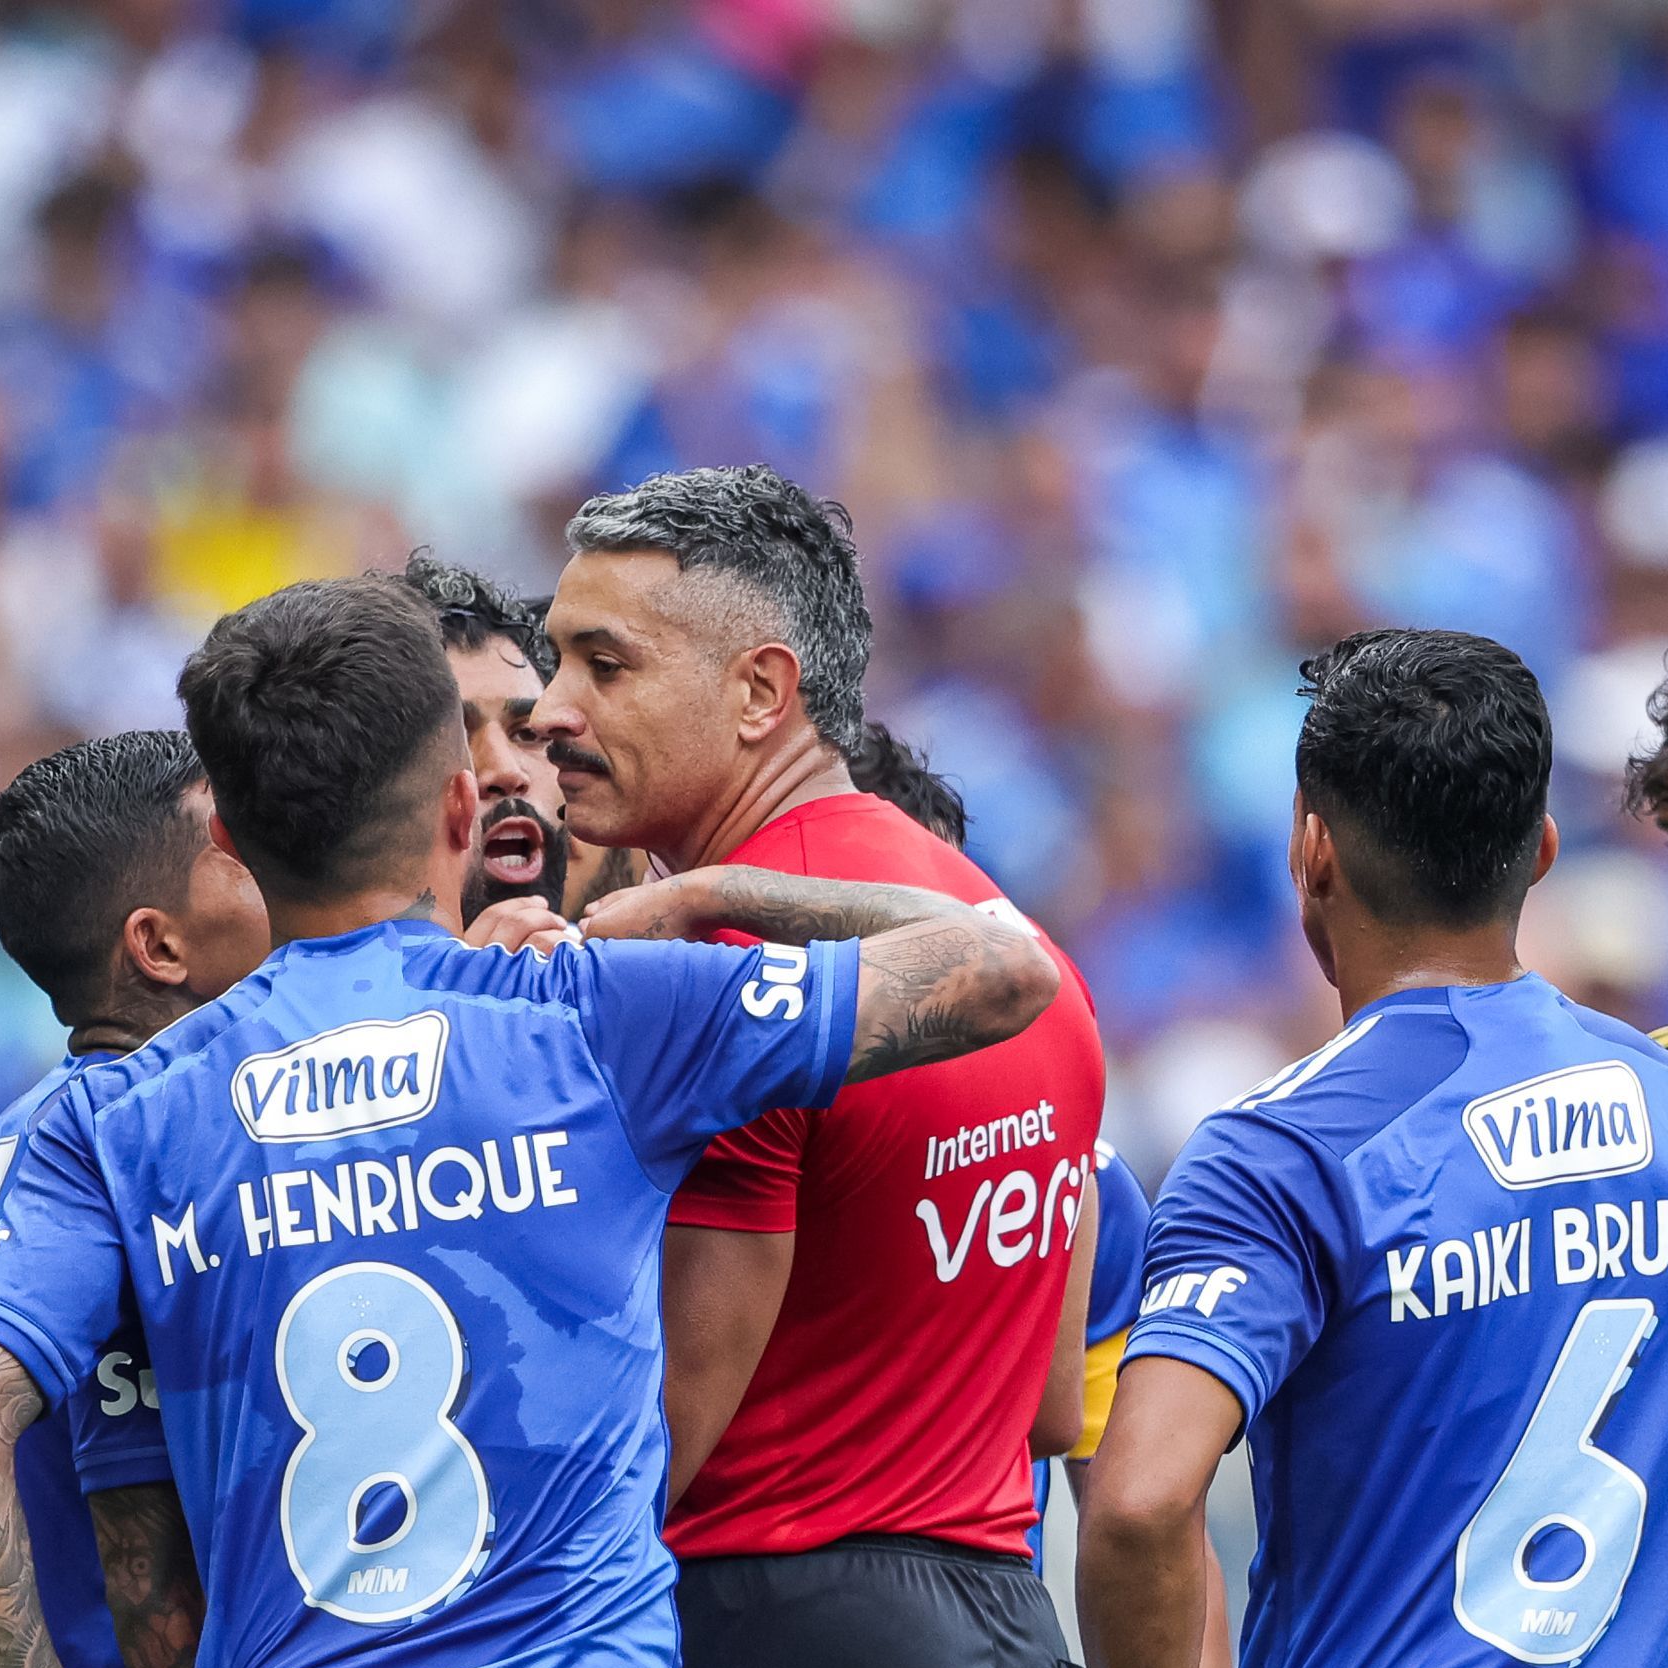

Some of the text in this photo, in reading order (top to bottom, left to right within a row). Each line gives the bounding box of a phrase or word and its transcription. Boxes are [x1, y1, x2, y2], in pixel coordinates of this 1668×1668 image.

[244, 1051, 420, 1122] Vilma
[1482, 1096, 1637, 1167] Vilma
[924, 1100, 1056, 1180] Internet
[151, 1131, 579, 1287] M. HENRIQUE
[1386, 1217, 1531, 1322] KAIKI
[275, 1261, 491, 1624] 8
[1453, 1298, 1655, 1665] 6
